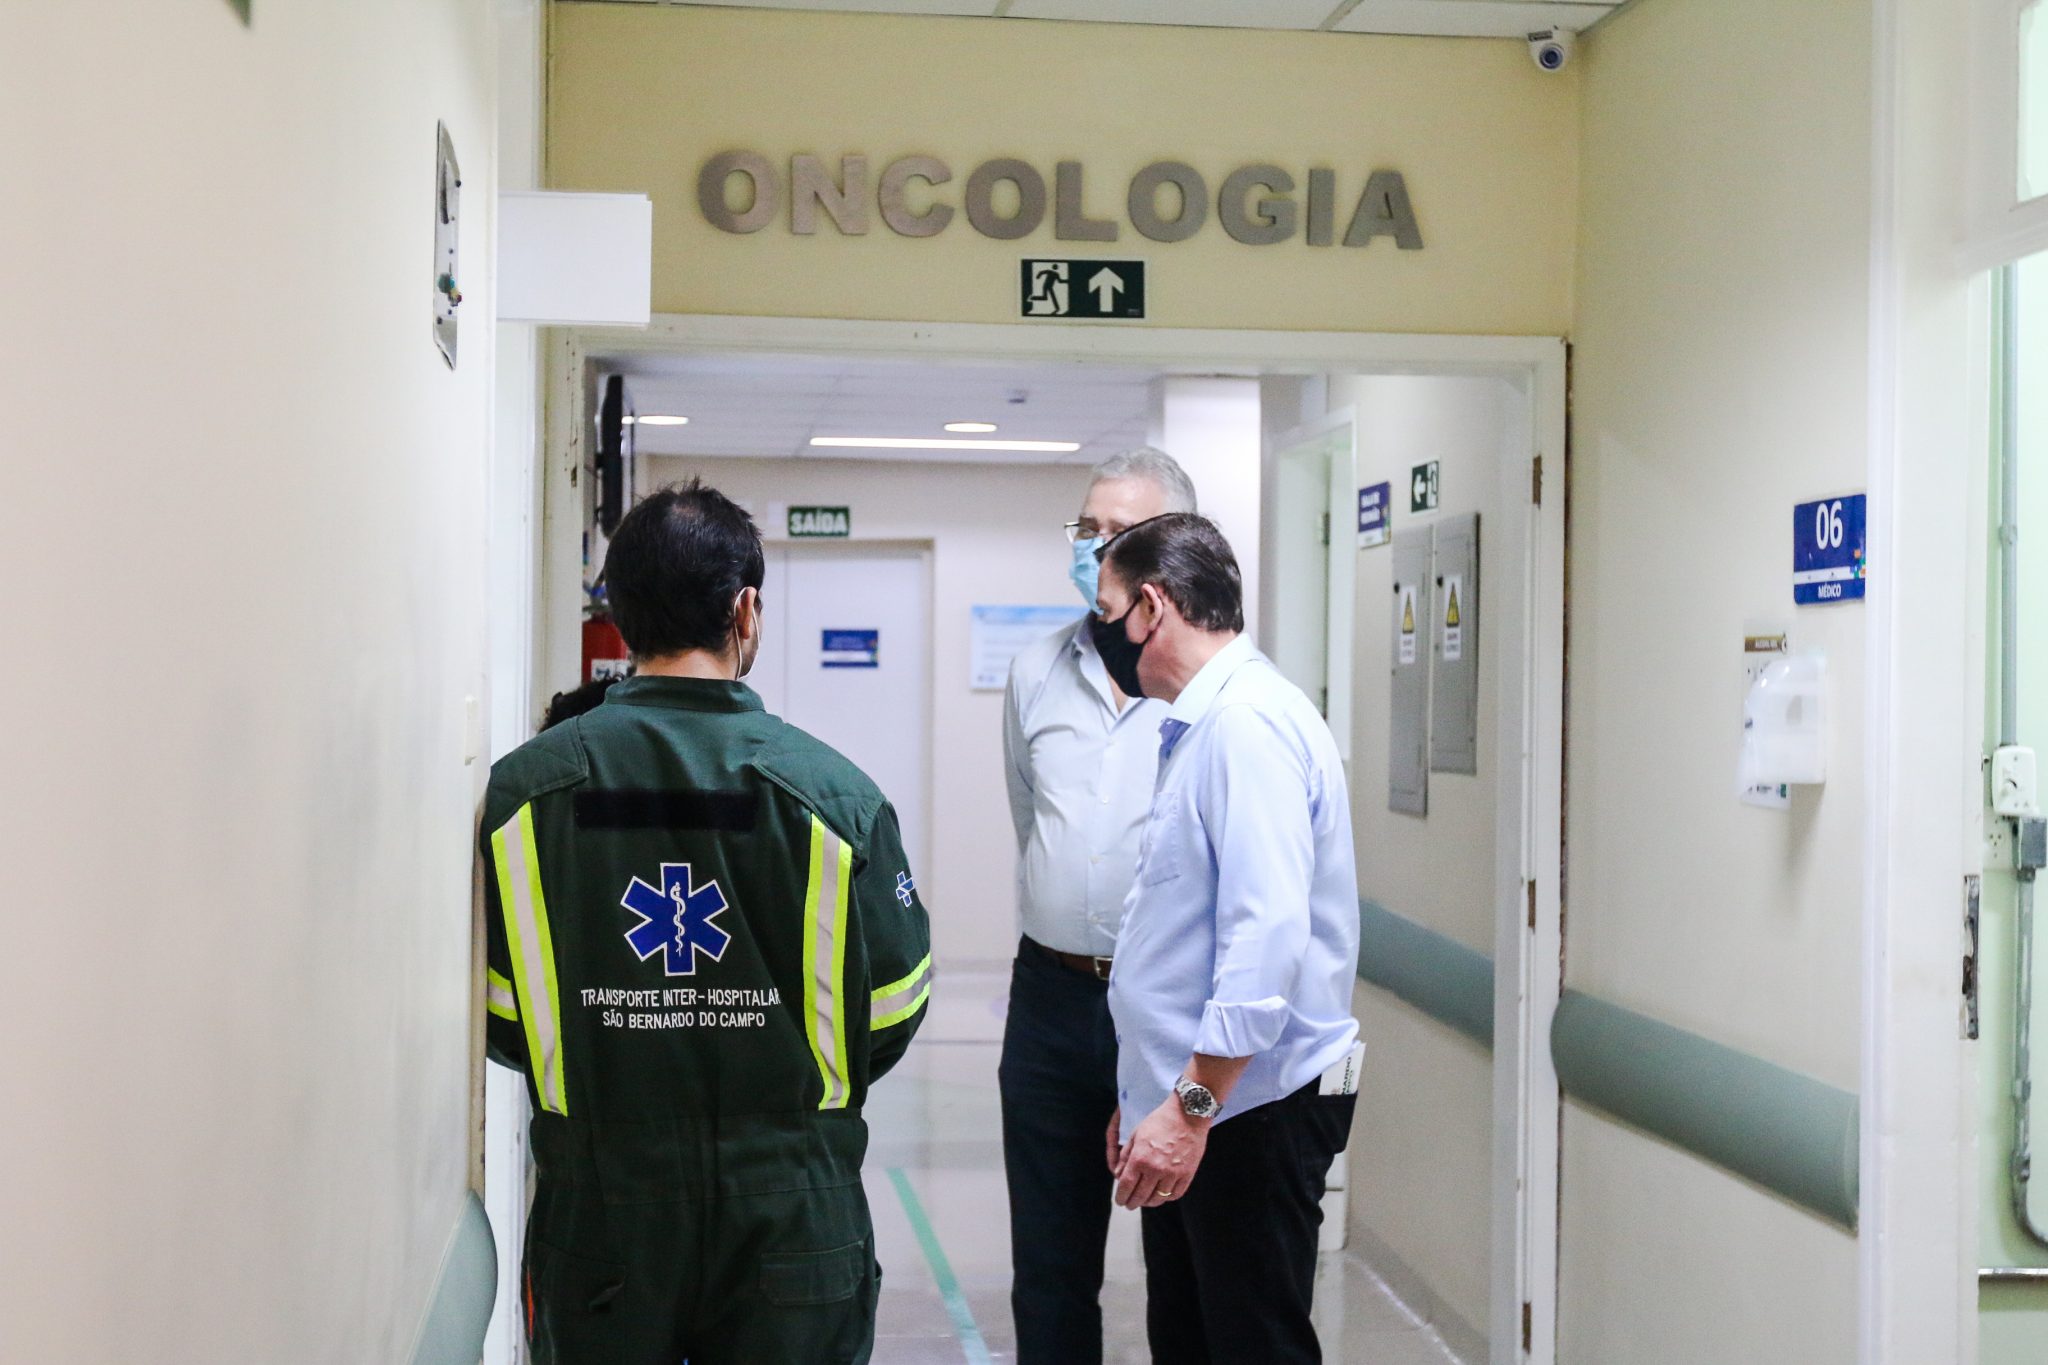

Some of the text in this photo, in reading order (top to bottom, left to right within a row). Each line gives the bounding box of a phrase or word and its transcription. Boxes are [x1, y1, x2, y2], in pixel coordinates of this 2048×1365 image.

[697, 149, 1424, 251] ONCOLOGIA
[790, 508, 849, 534] SAÍDA
[1816, 500, 1843, 550] 06
[1818, 582, 1842, 599] MÉDICO
[580, 988, 660, 1008] TRANSPORTE
[602, 1008, 766, 1029] SÃO BERNARDO DO CAMPO
